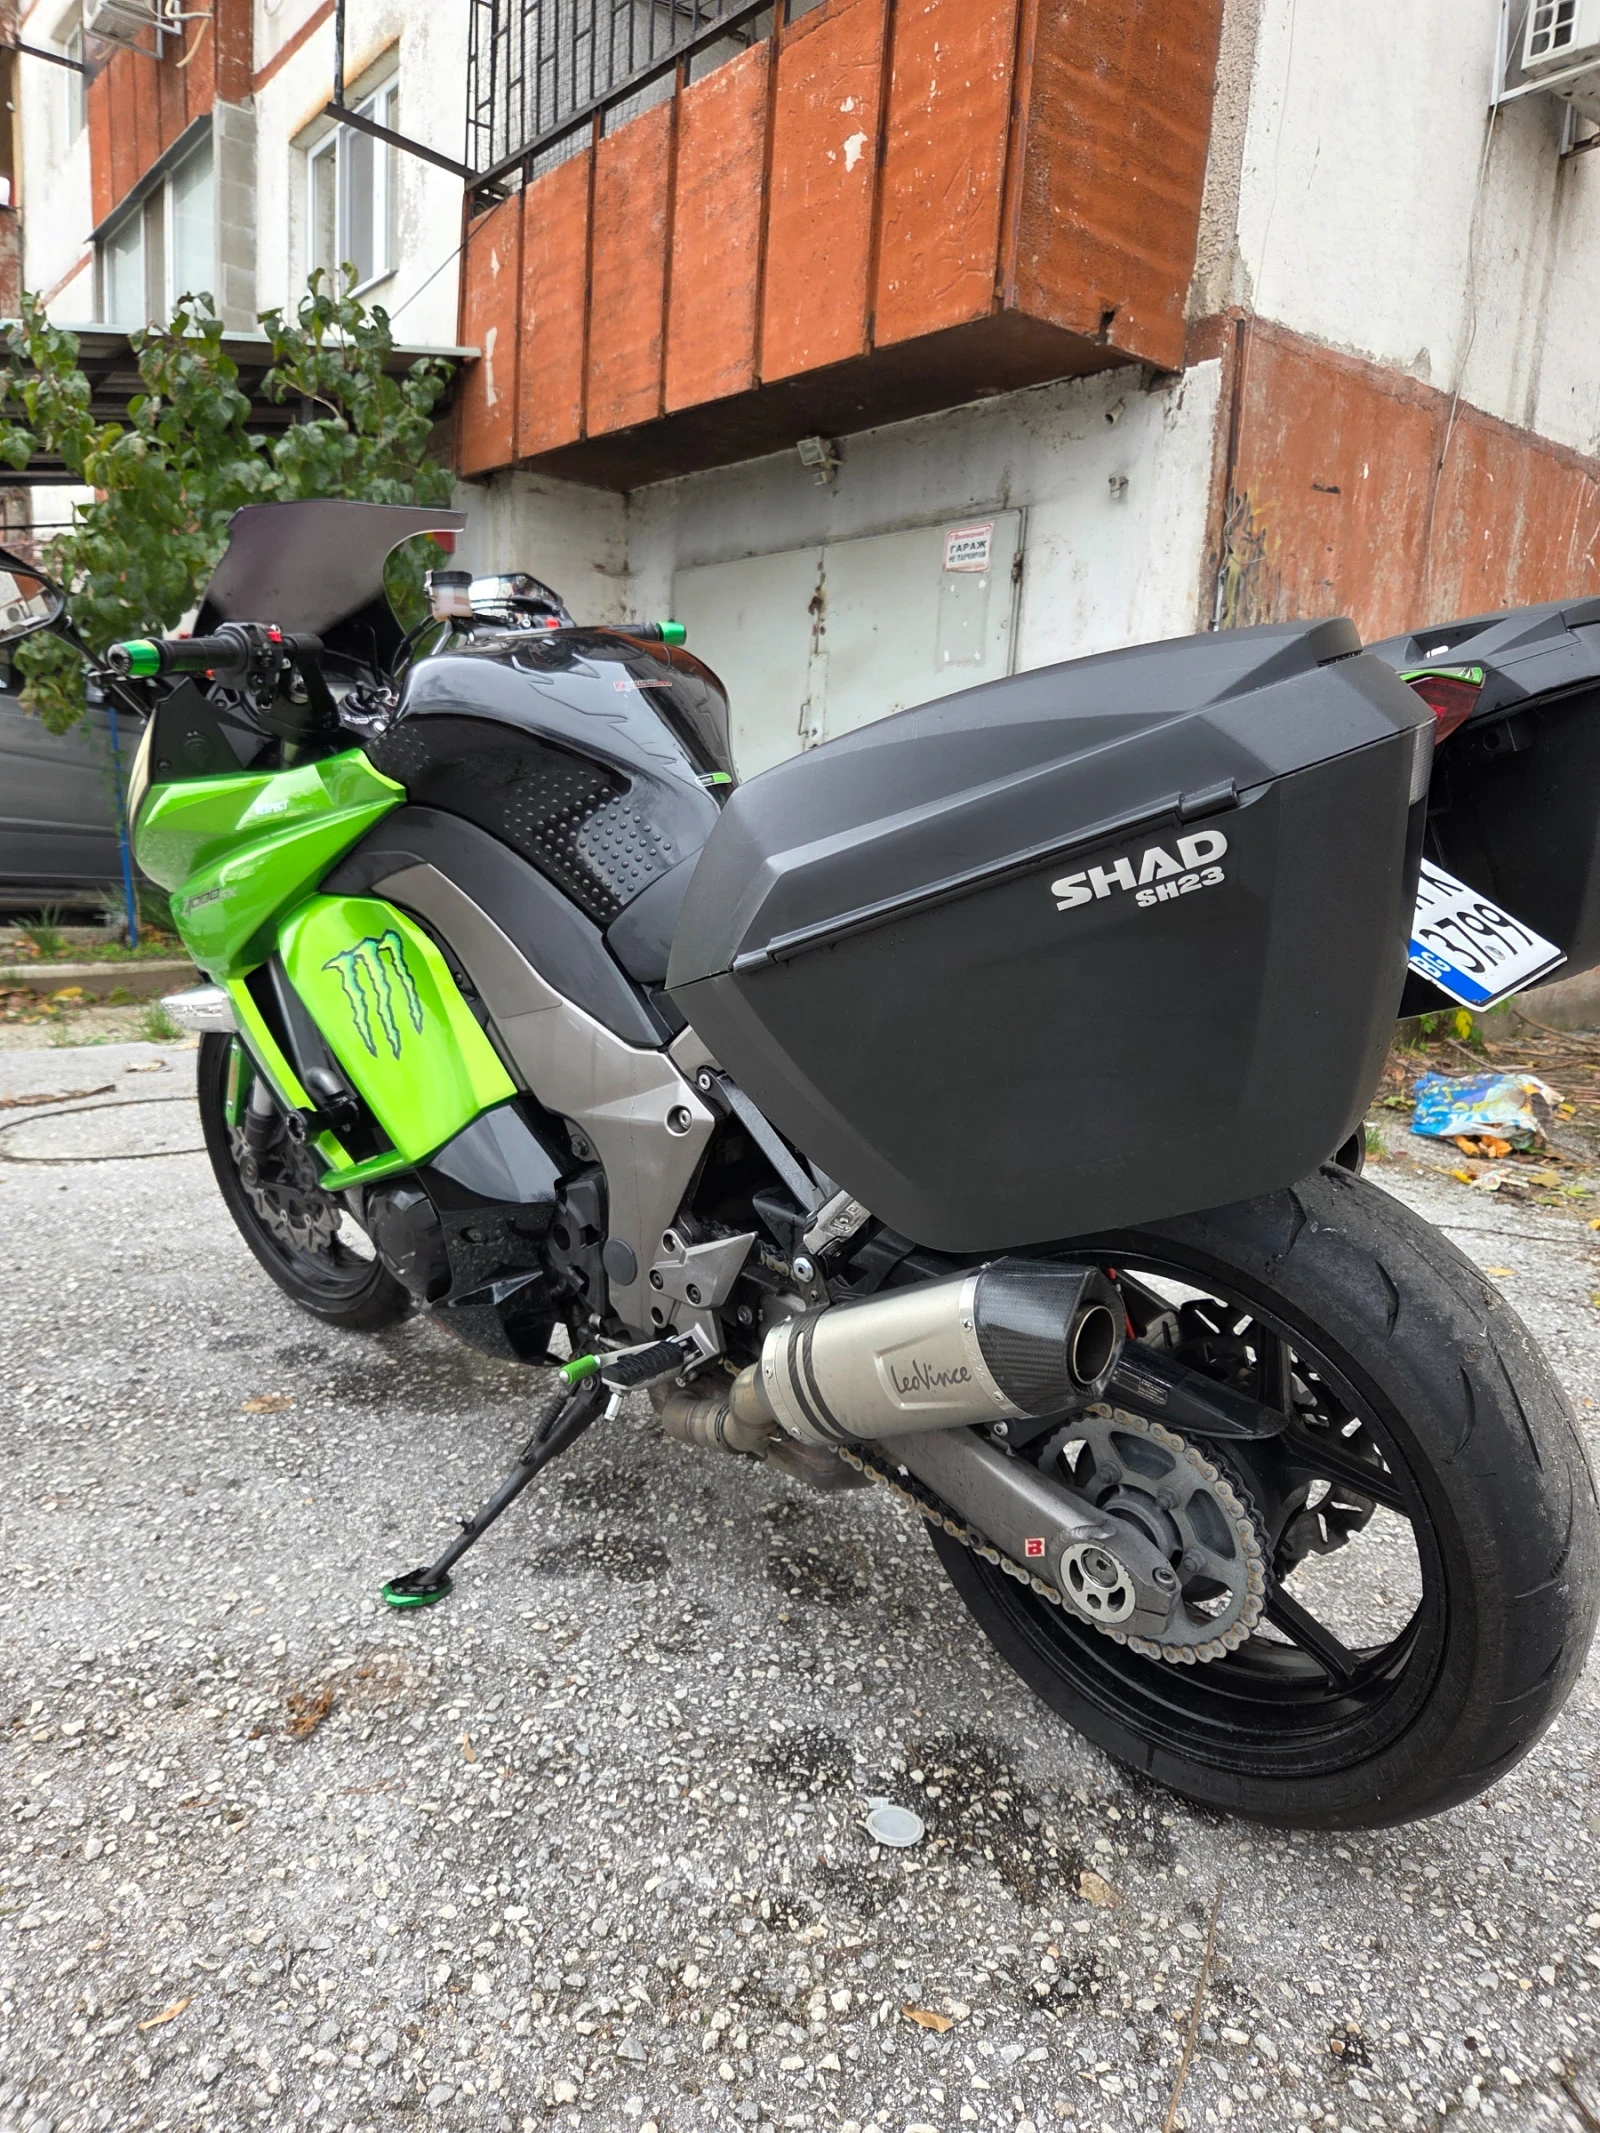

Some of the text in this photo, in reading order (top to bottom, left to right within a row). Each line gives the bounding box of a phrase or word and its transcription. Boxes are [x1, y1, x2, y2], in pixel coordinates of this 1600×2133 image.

[950, 540, 987, 553] ГАРАЖ
[1051, 830, 1228, 911] SHAD
[1135, 866, 1225, 907] SH23
[1419, 903, 1534, 973] 3799
[1409, 951, 1452, 979] BG
[890, 1359, 972, 1394] LeoVince
